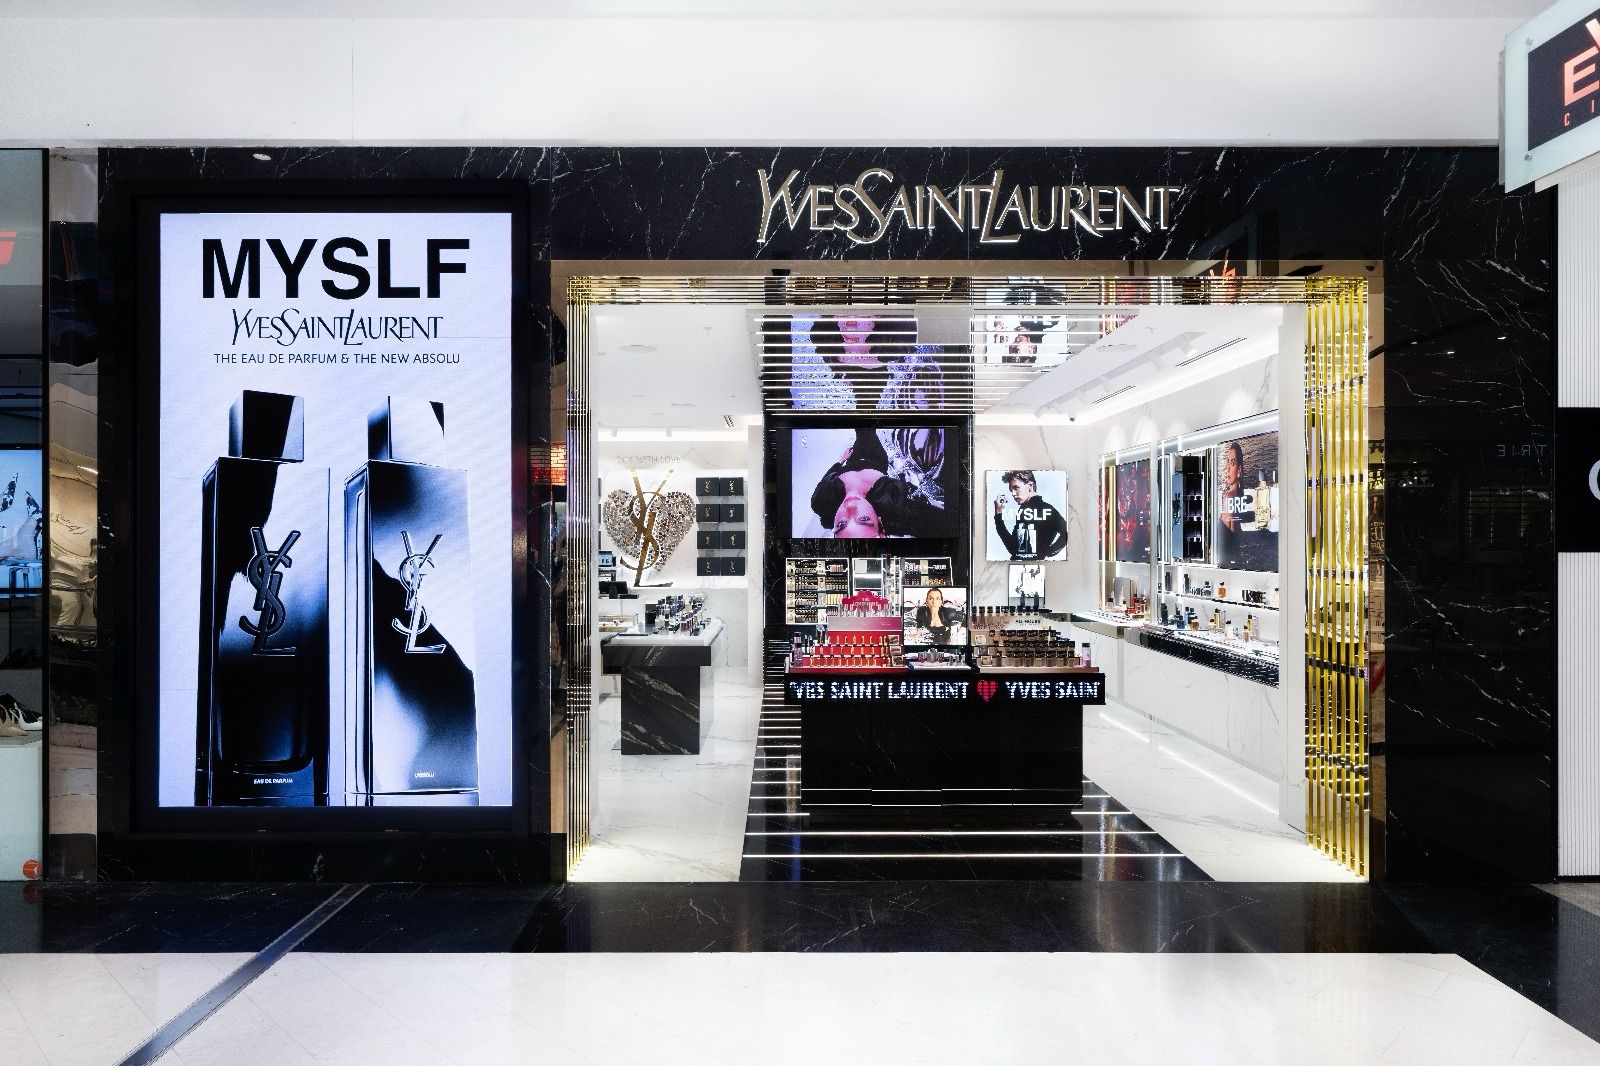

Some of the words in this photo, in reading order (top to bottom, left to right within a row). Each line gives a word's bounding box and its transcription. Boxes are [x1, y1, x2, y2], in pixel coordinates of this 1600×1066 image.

[202, 236, 470, 300] MYSLF
[214, 353, 237, 364] THE
[241, 353, 265, 364] EAU
[269, 353, 285, 364] DE
[289, 353, 337, 364] PARFUM
[341, 353, 349, 364] &
[354, 353, 377, 364] THE
[381, 353, 410, 364] NEW
[413, 353, 460, 364] ABSOLU
[1002, 508, 1052, 521] MYSLF
[830, 681, 884, 699] SAINT
[887, 681, 969, 699] LAURENT
[1005, 681, 1051, 699] YVES
[1055, 681, 1100, 699] SAIN
